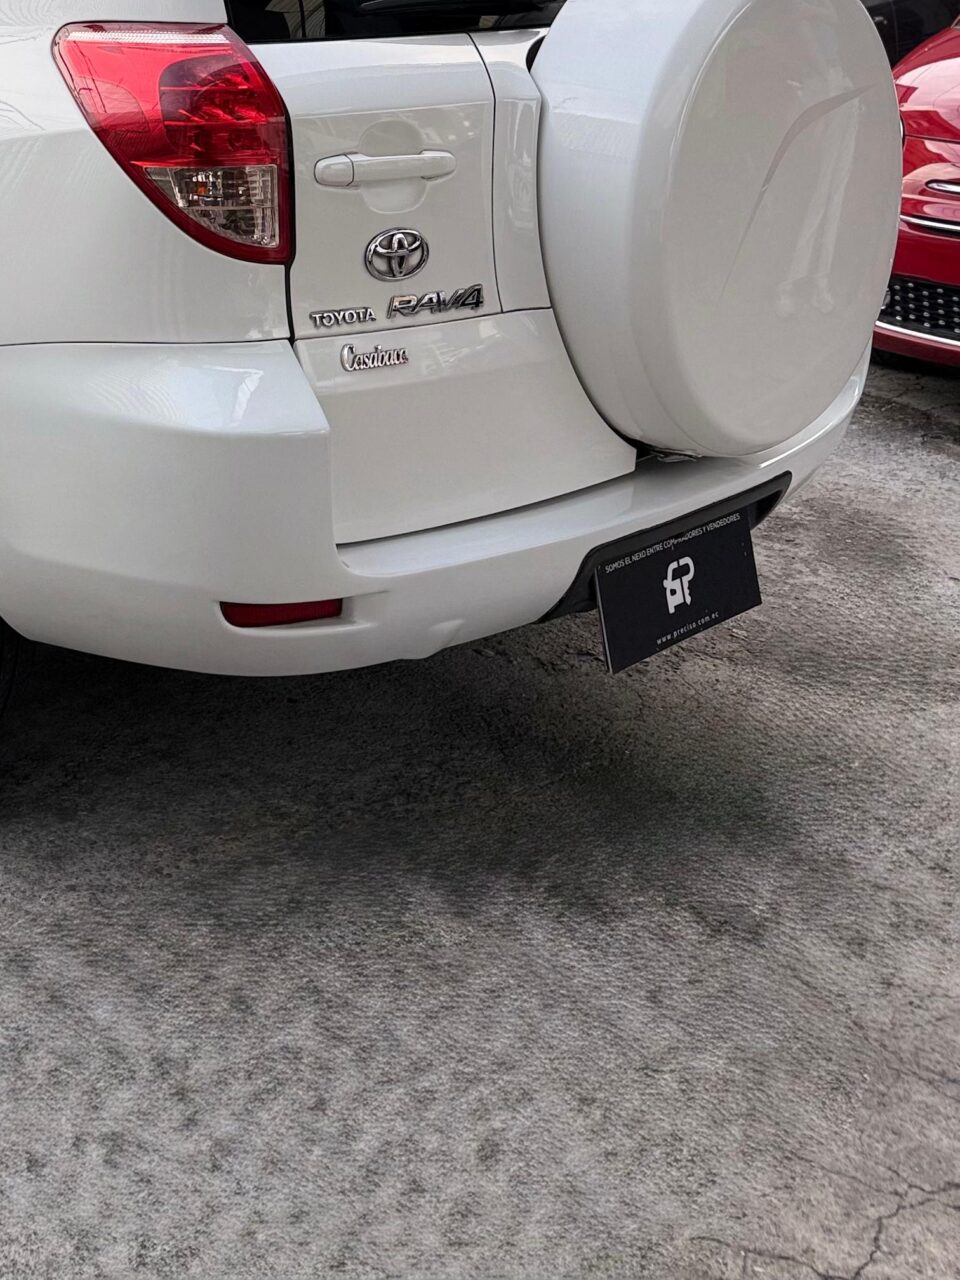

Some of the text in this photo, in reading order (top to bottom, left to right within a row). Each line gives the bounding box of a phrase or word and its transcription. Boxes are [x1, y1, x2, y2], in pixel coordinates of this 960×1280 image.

[310, 284, 484, 328] TOYOTA RAV4
[605, 559, 625, 574] SOMOS
[632, 550, 646, 562] NEXO
[646, 544, 664, 556] ENTRE
[707, 513, 740, 531] VENDEDORES
